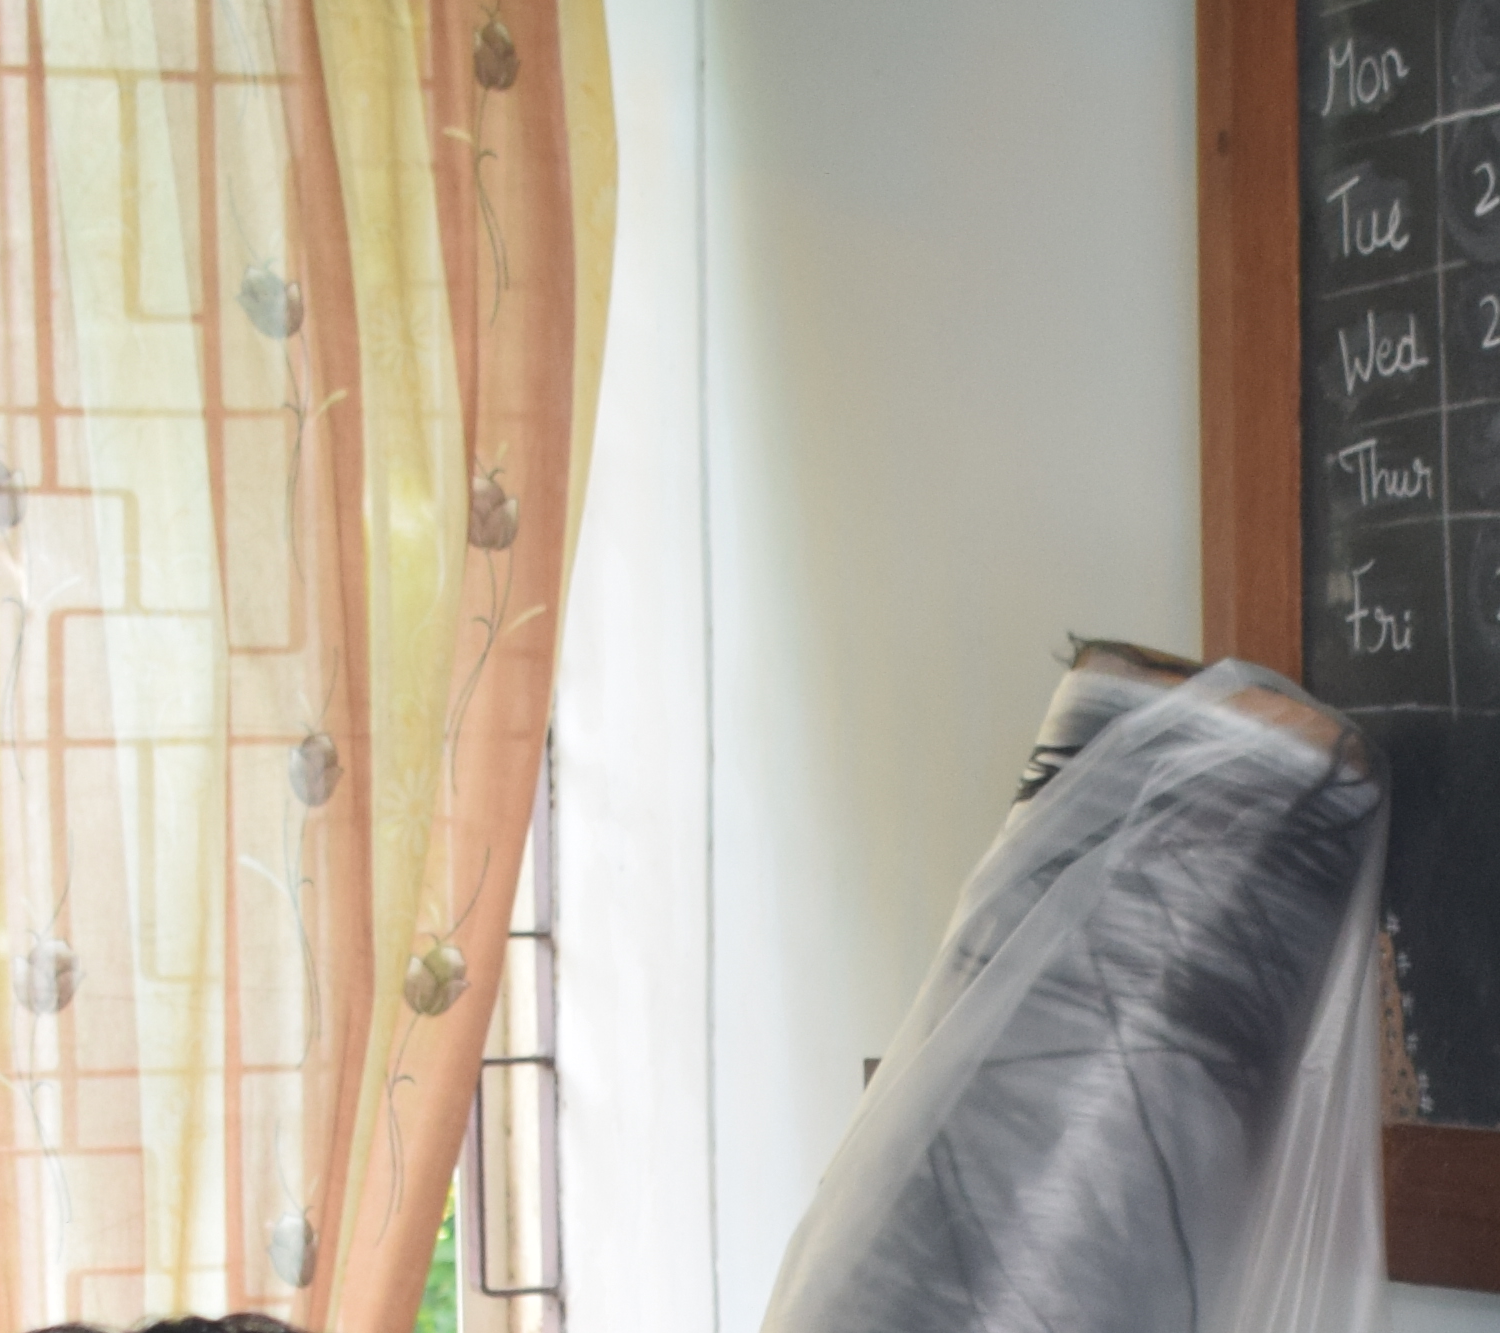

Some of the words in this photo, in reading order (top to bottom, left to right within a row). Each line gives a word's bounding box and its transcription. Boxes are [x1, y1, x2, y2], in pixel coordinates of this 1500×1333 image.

[1320, 37, 1410, 117] Mon
[1325, 175, 1411, 258] Tue
[1338, 309, 1430, 395] Wed
[1338, 437, 1434, 505] Thur
[1345, 558, 1413, 653] Fri
